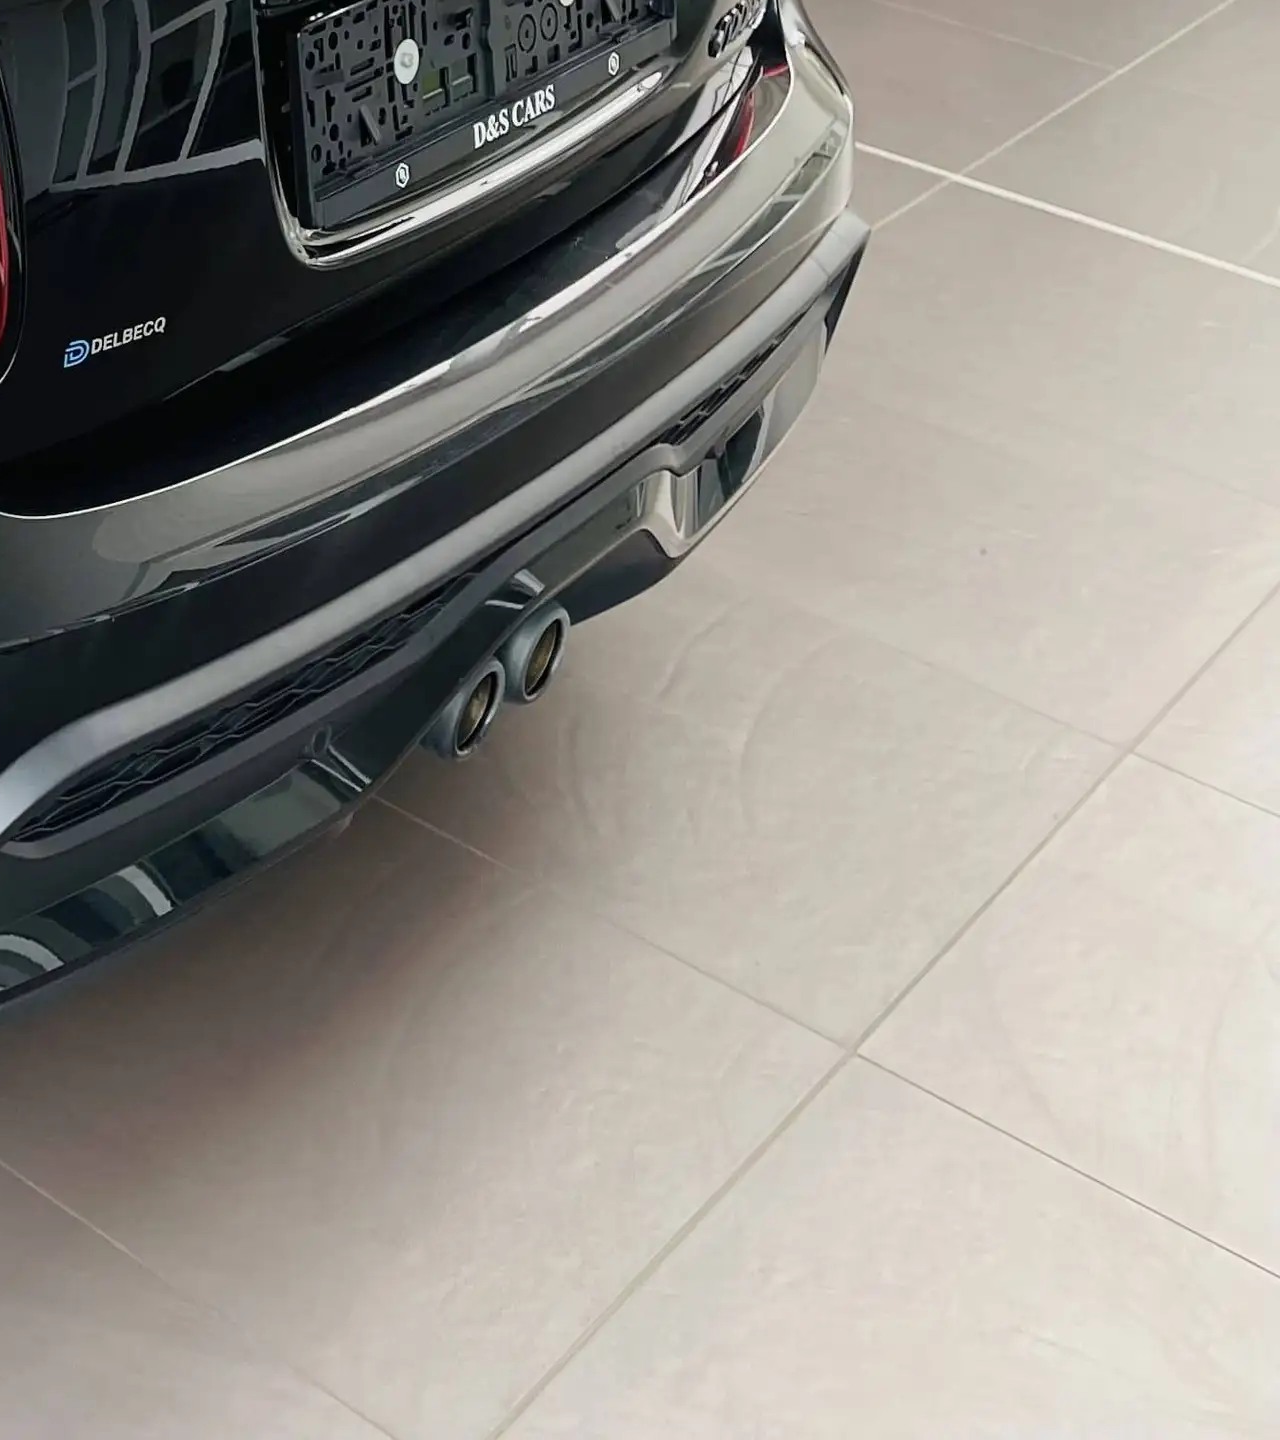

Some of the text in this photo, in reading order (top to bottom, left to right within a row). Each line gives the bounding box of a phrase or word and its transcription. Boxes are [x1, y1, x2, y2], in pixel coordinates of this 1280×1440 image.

[473, 83, 556, 149] D&S CARS
[91, 317, 166, 355] DELBECQ
